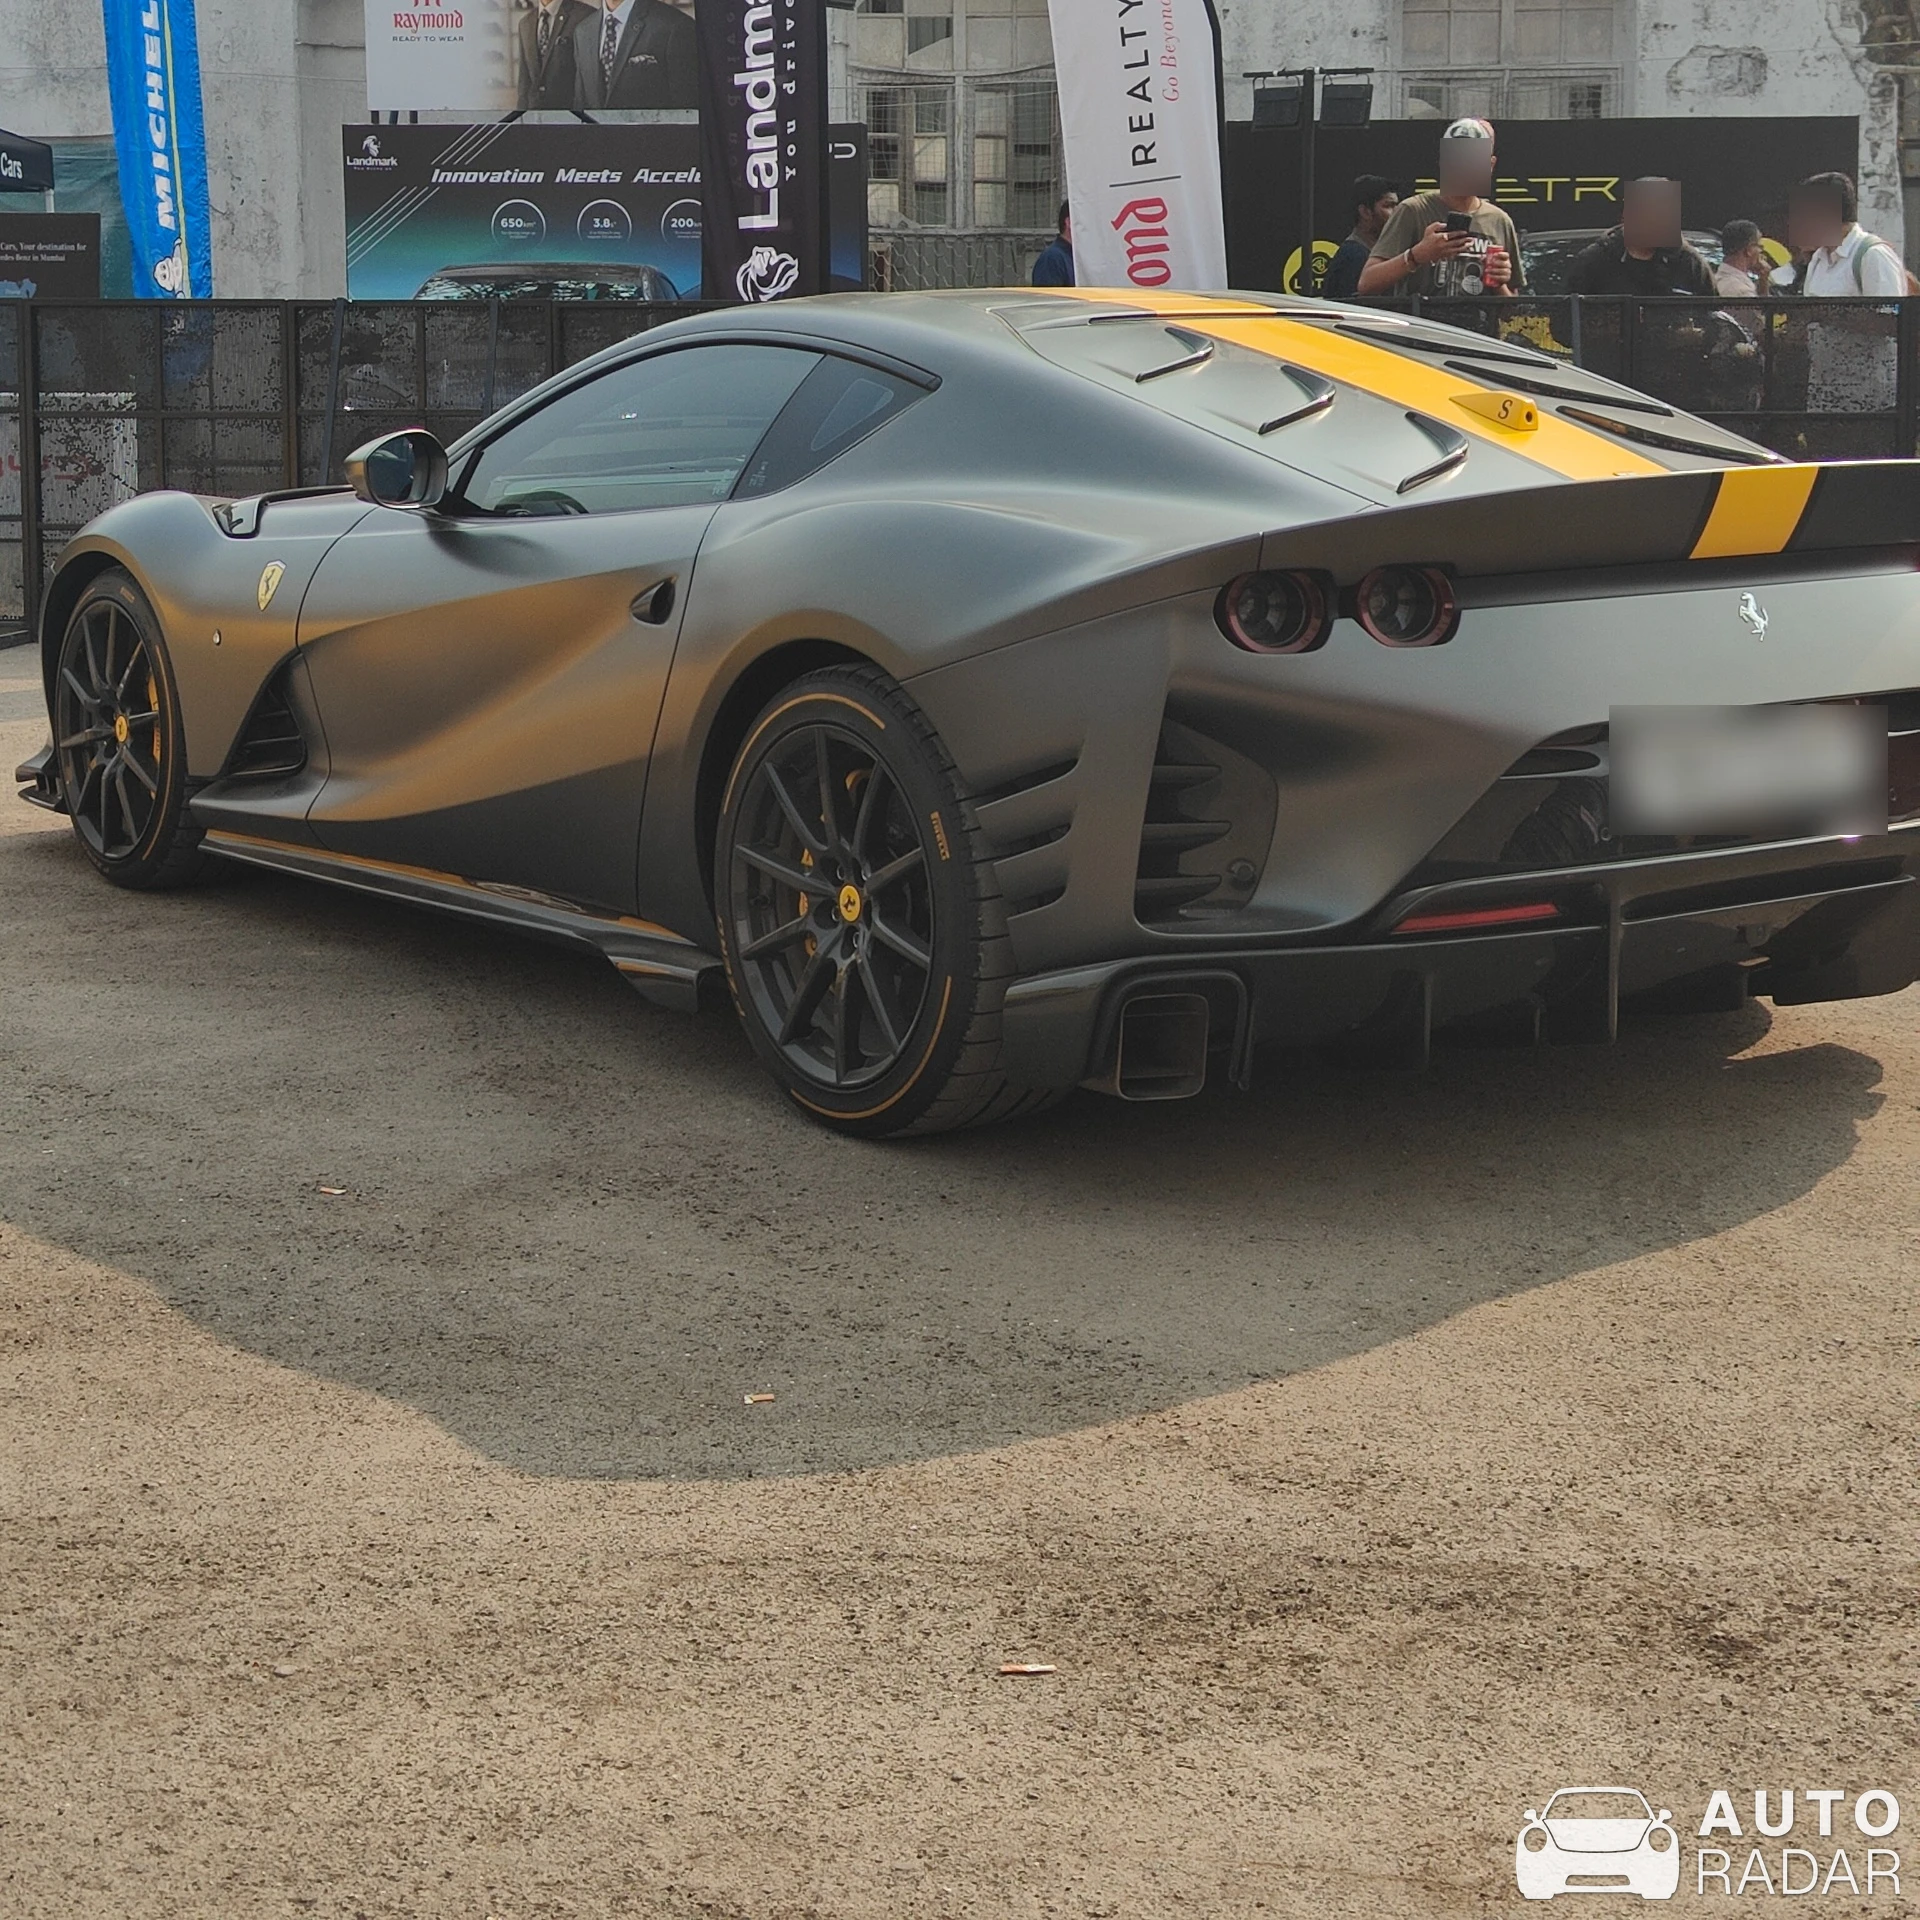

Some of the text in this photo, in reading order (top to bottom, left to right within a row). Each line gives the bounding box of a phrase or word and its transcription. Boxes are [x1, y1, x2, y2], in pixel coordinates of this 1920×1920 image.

[393, 10, 463, 34] Raymond
[1118, 0, 1157, 167] REALTY
[1162, 76, 1179, 102] Go
[734, 0, 779, 230] Landm
[346, 156, 398, 166] Landmark
[785, 119, 797, 182] You
[1, 152, 23, 179] Cars
[431, 168, 545, 183] Innovation
[555, 168, 623, 183] Meets
